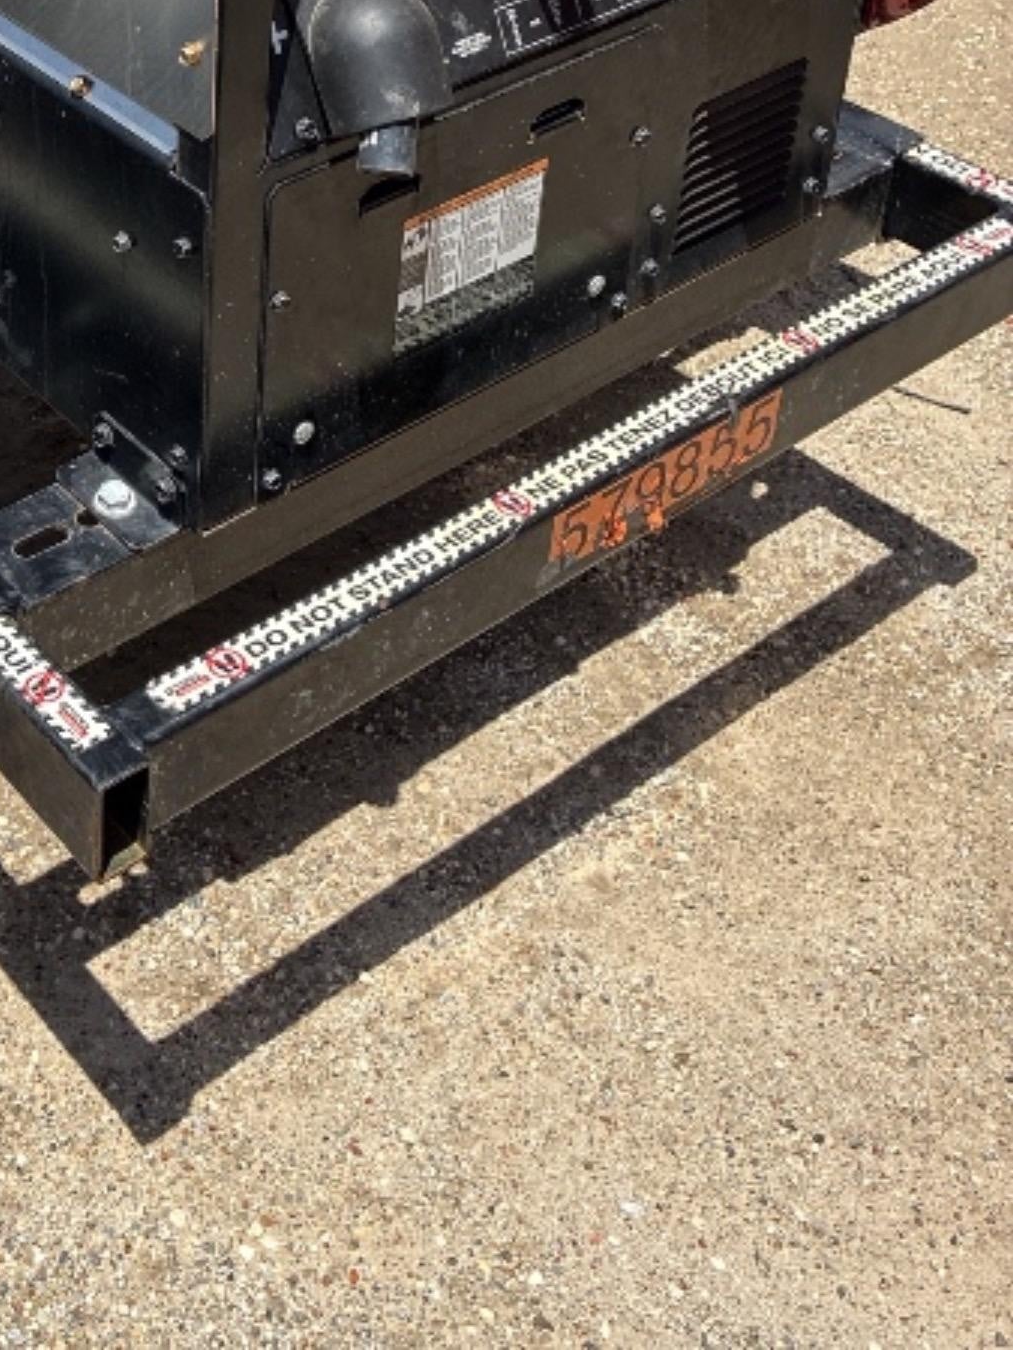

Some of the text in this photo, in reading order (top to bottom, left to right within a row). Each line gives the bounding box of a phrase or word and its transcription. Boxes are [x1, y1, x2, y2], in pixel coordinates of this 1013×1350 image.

[245, 628, 288, 659] DO
[290, 597, 346, 634] NOT
[347, 548, 436, 601] STAND
[433, 509, 504, 554] HERE
[524, 476, 563, 500] NE
[560, 448, 609, 481] PAS
[605, 409, 677, 454] TENEZ
[676, 360, 760, 413] DEBOUT
